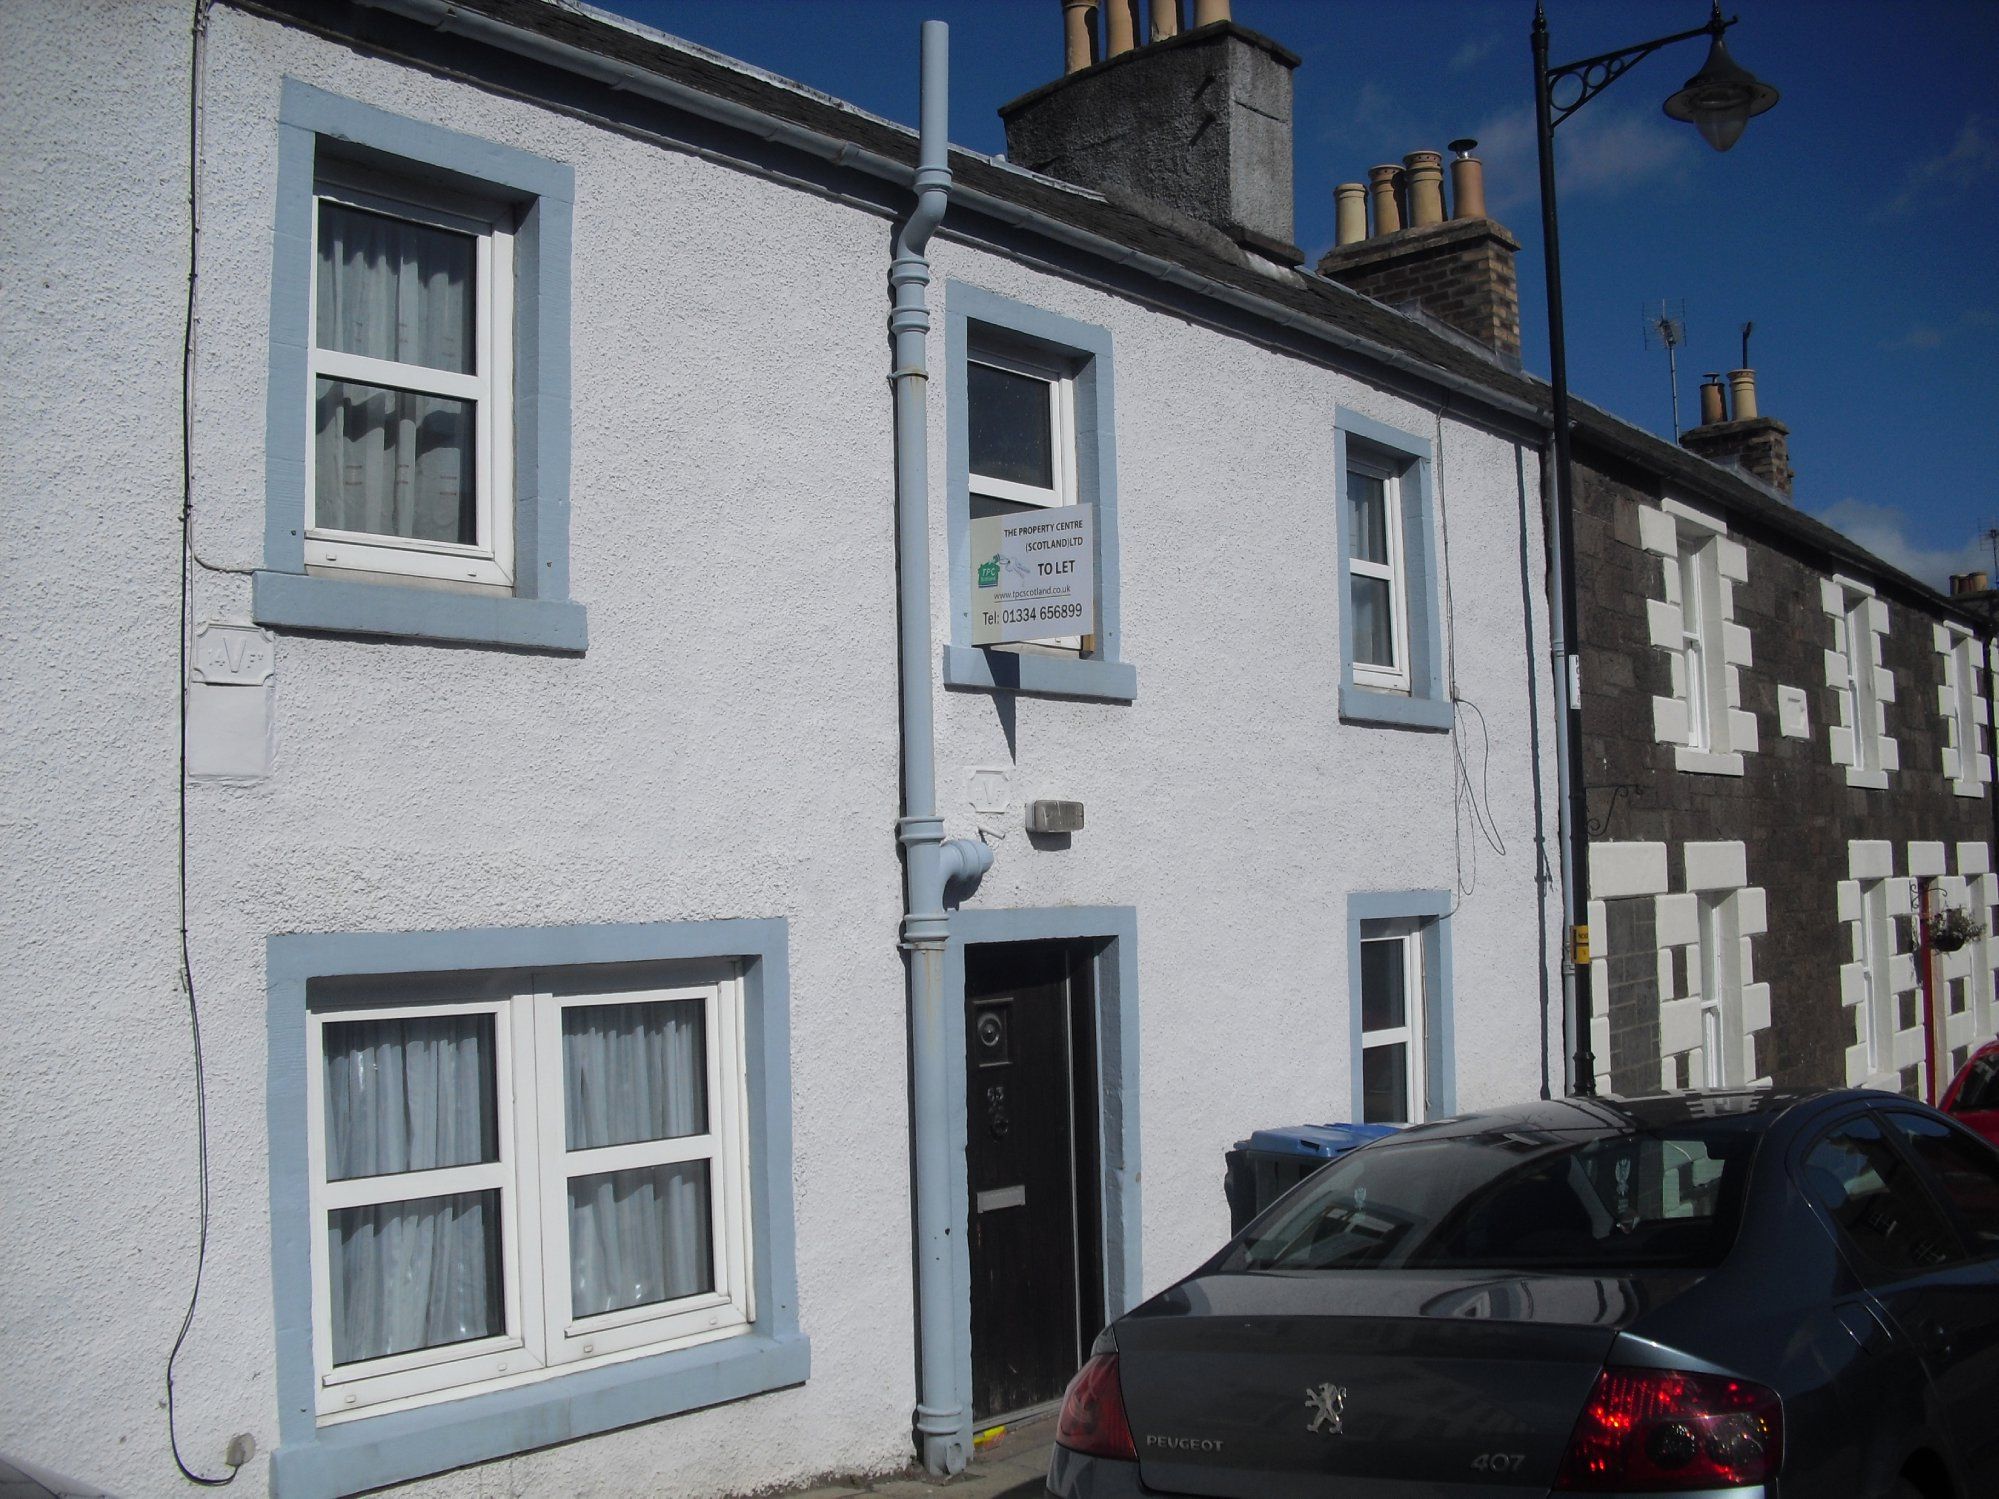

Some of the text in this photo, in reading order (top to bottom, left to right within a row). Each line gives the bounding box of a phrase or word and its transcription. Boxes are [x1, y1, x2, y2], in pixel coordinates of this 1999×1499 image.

[1004, 520, 1083, 538] THE PROPERTY CENTRE
[982, 567, 996, 577] TPC
[1038, 560, 1075, 576] TO LET
[994, 585, 1071, 600] www.tpcscotland.co.uk
[983, 603, 1082, 626] Tel: 01334 656899
[1146, 1435, 1224, 1453] PEUGEOT
[1469, 1453, 1527, 1473] 407
